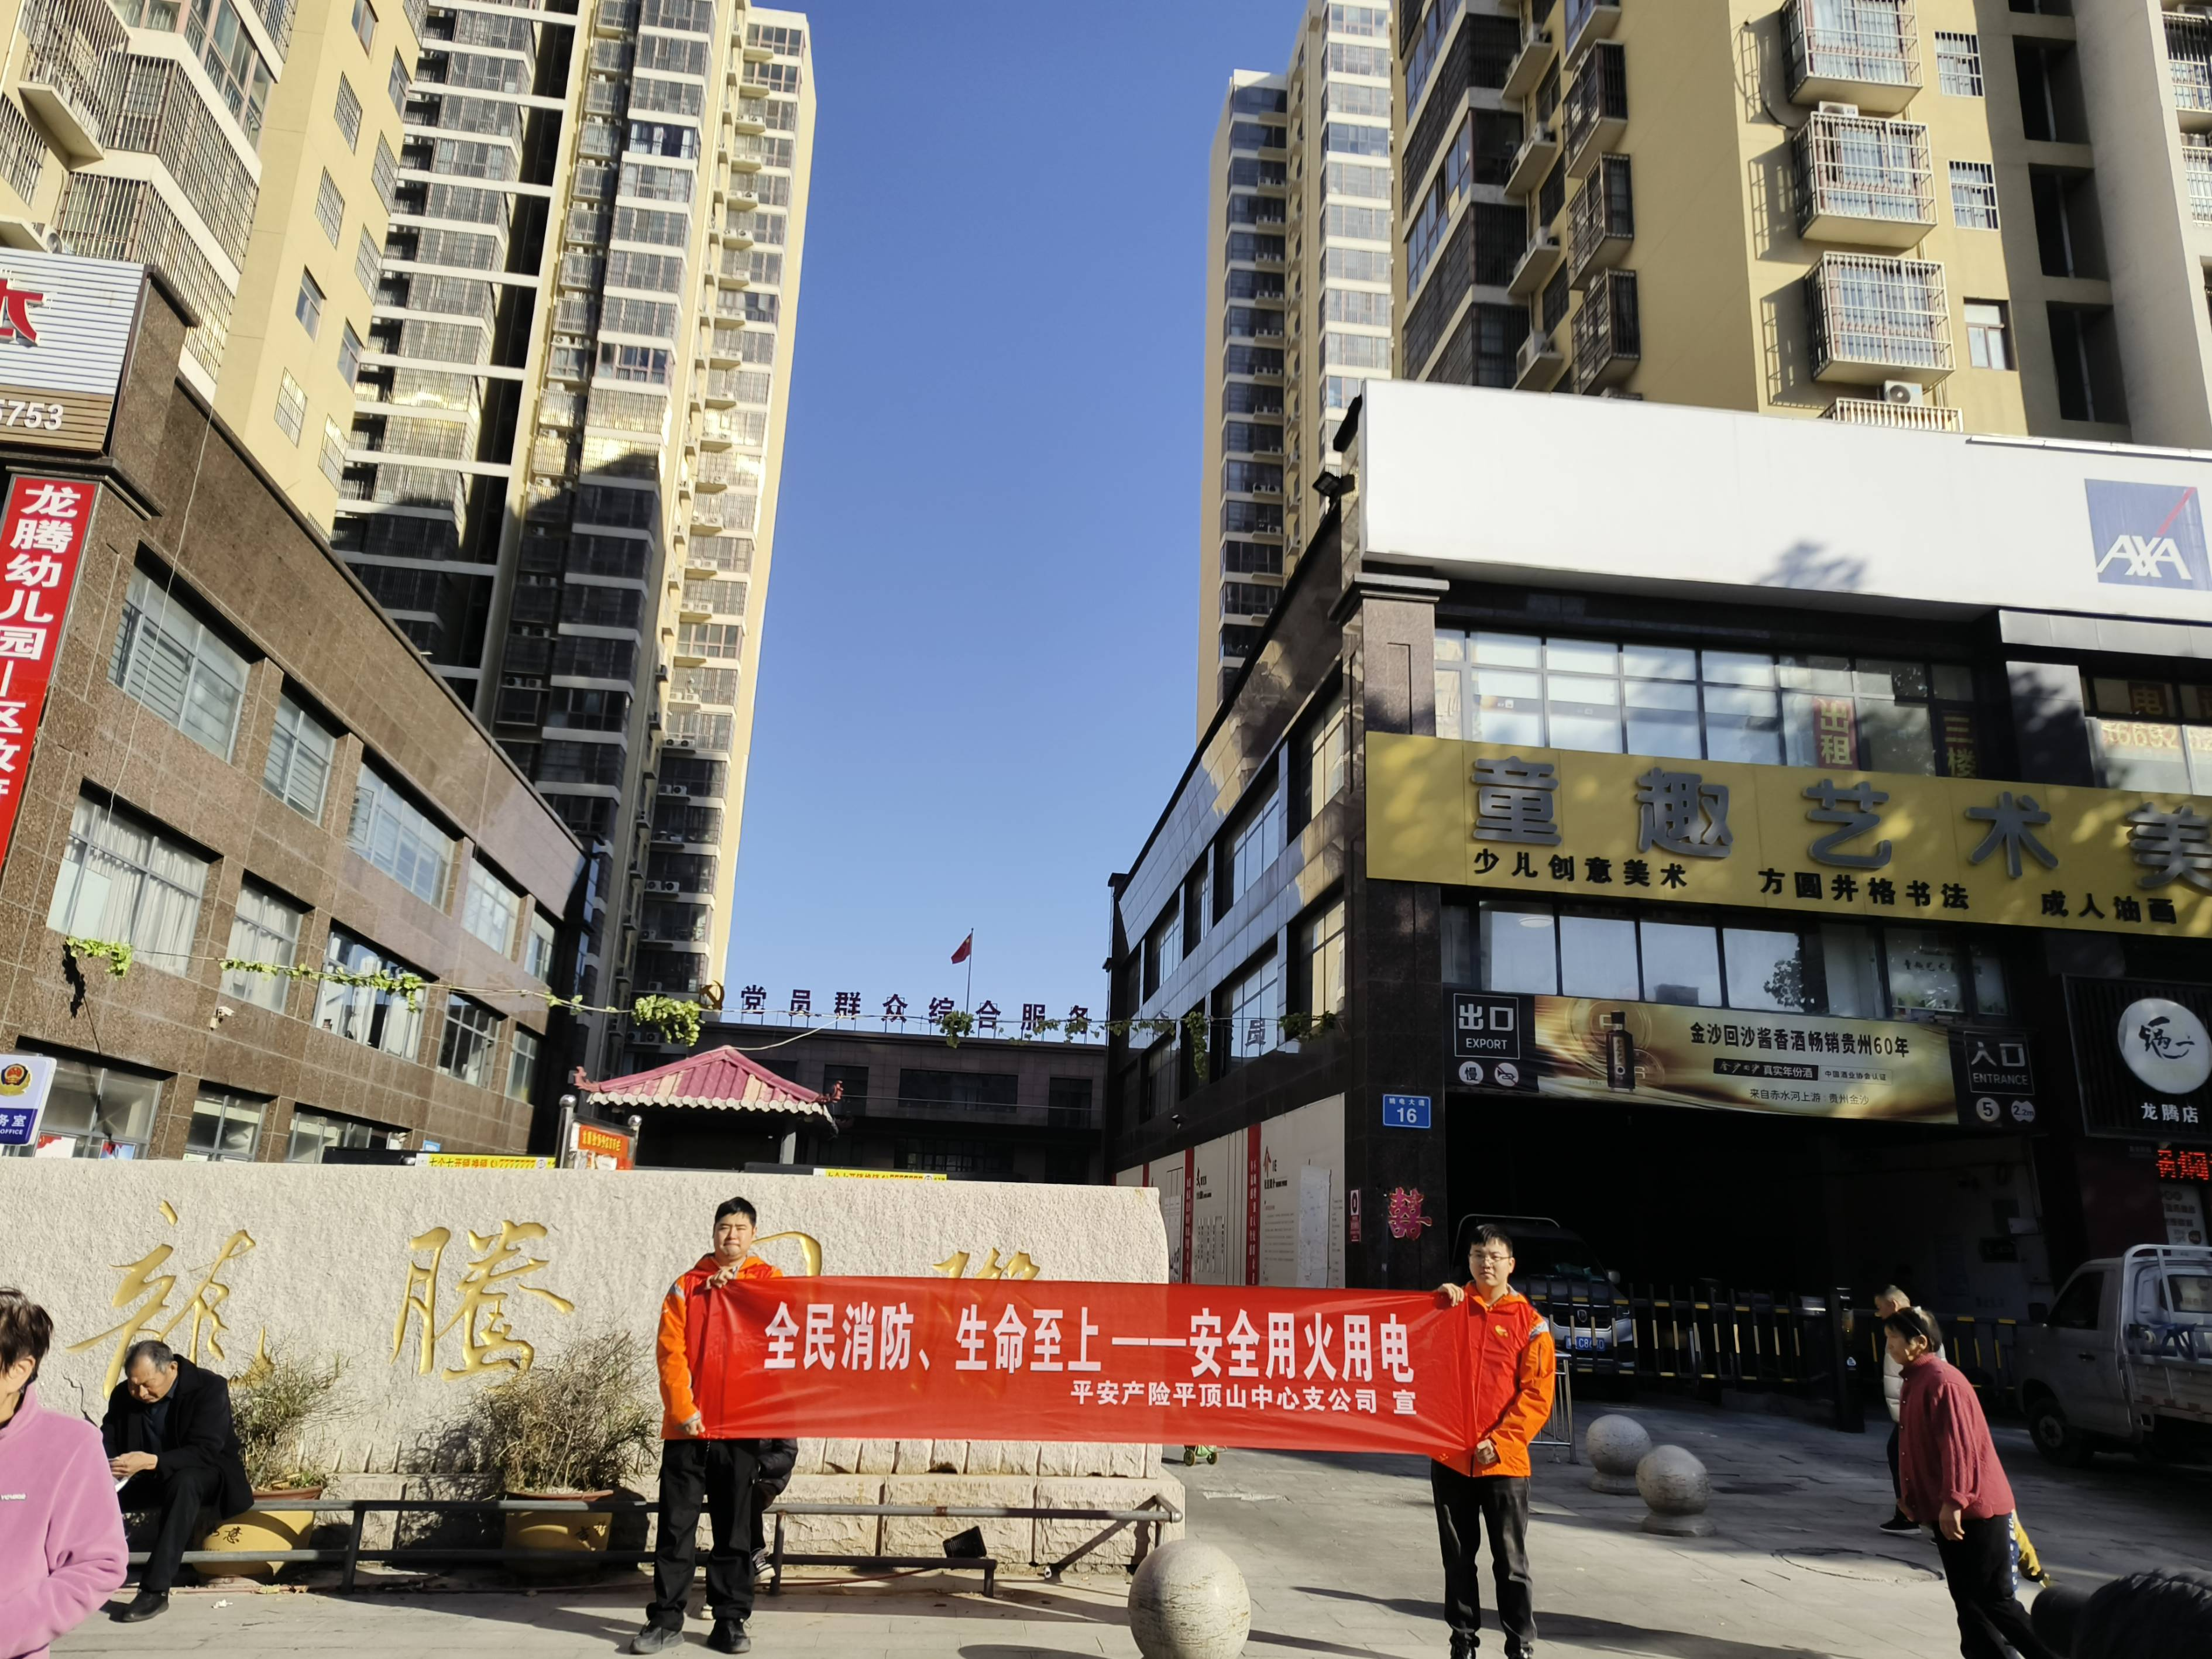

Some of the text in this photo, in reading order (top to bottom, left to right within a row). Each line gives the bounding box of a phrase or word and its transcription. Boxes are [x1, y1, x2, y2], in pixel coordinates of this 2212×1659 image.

[2096, 535, 2193, 580] AXA
[1818, 699, 1853, 765] 出租
[1473, 849, 1687, 889] 少儿创意美术
[1758, 867, 1969, 911] 方圆井格书法
[2041, 889, 2177, 925] 成人油画
[1459, 1004, 1514, 1032] 出口
[1466, 1038, 1507, 1050] EXPORT
[1689, 1021, 1909, 1057] 金沙回沙酱香酒畅销贵州60年
[1971, 1041, 2025, 1067] 入口
[1763, 1064, 1813, 1078] 真实年份酒
[1825, 1070, 1887, 1081] 中国酒业协会认证
[1973, 1073, 2028, 1085] ENTRANCE
[1397, 1107, 1417, 1124] 16
[1983, 1101, 1994, 1117] 5
[2141, 1102, 2199, 1124] 龙腾店
[1071, 1379, 1417, 1416] 平安产险平顶山中心支公司 宣
